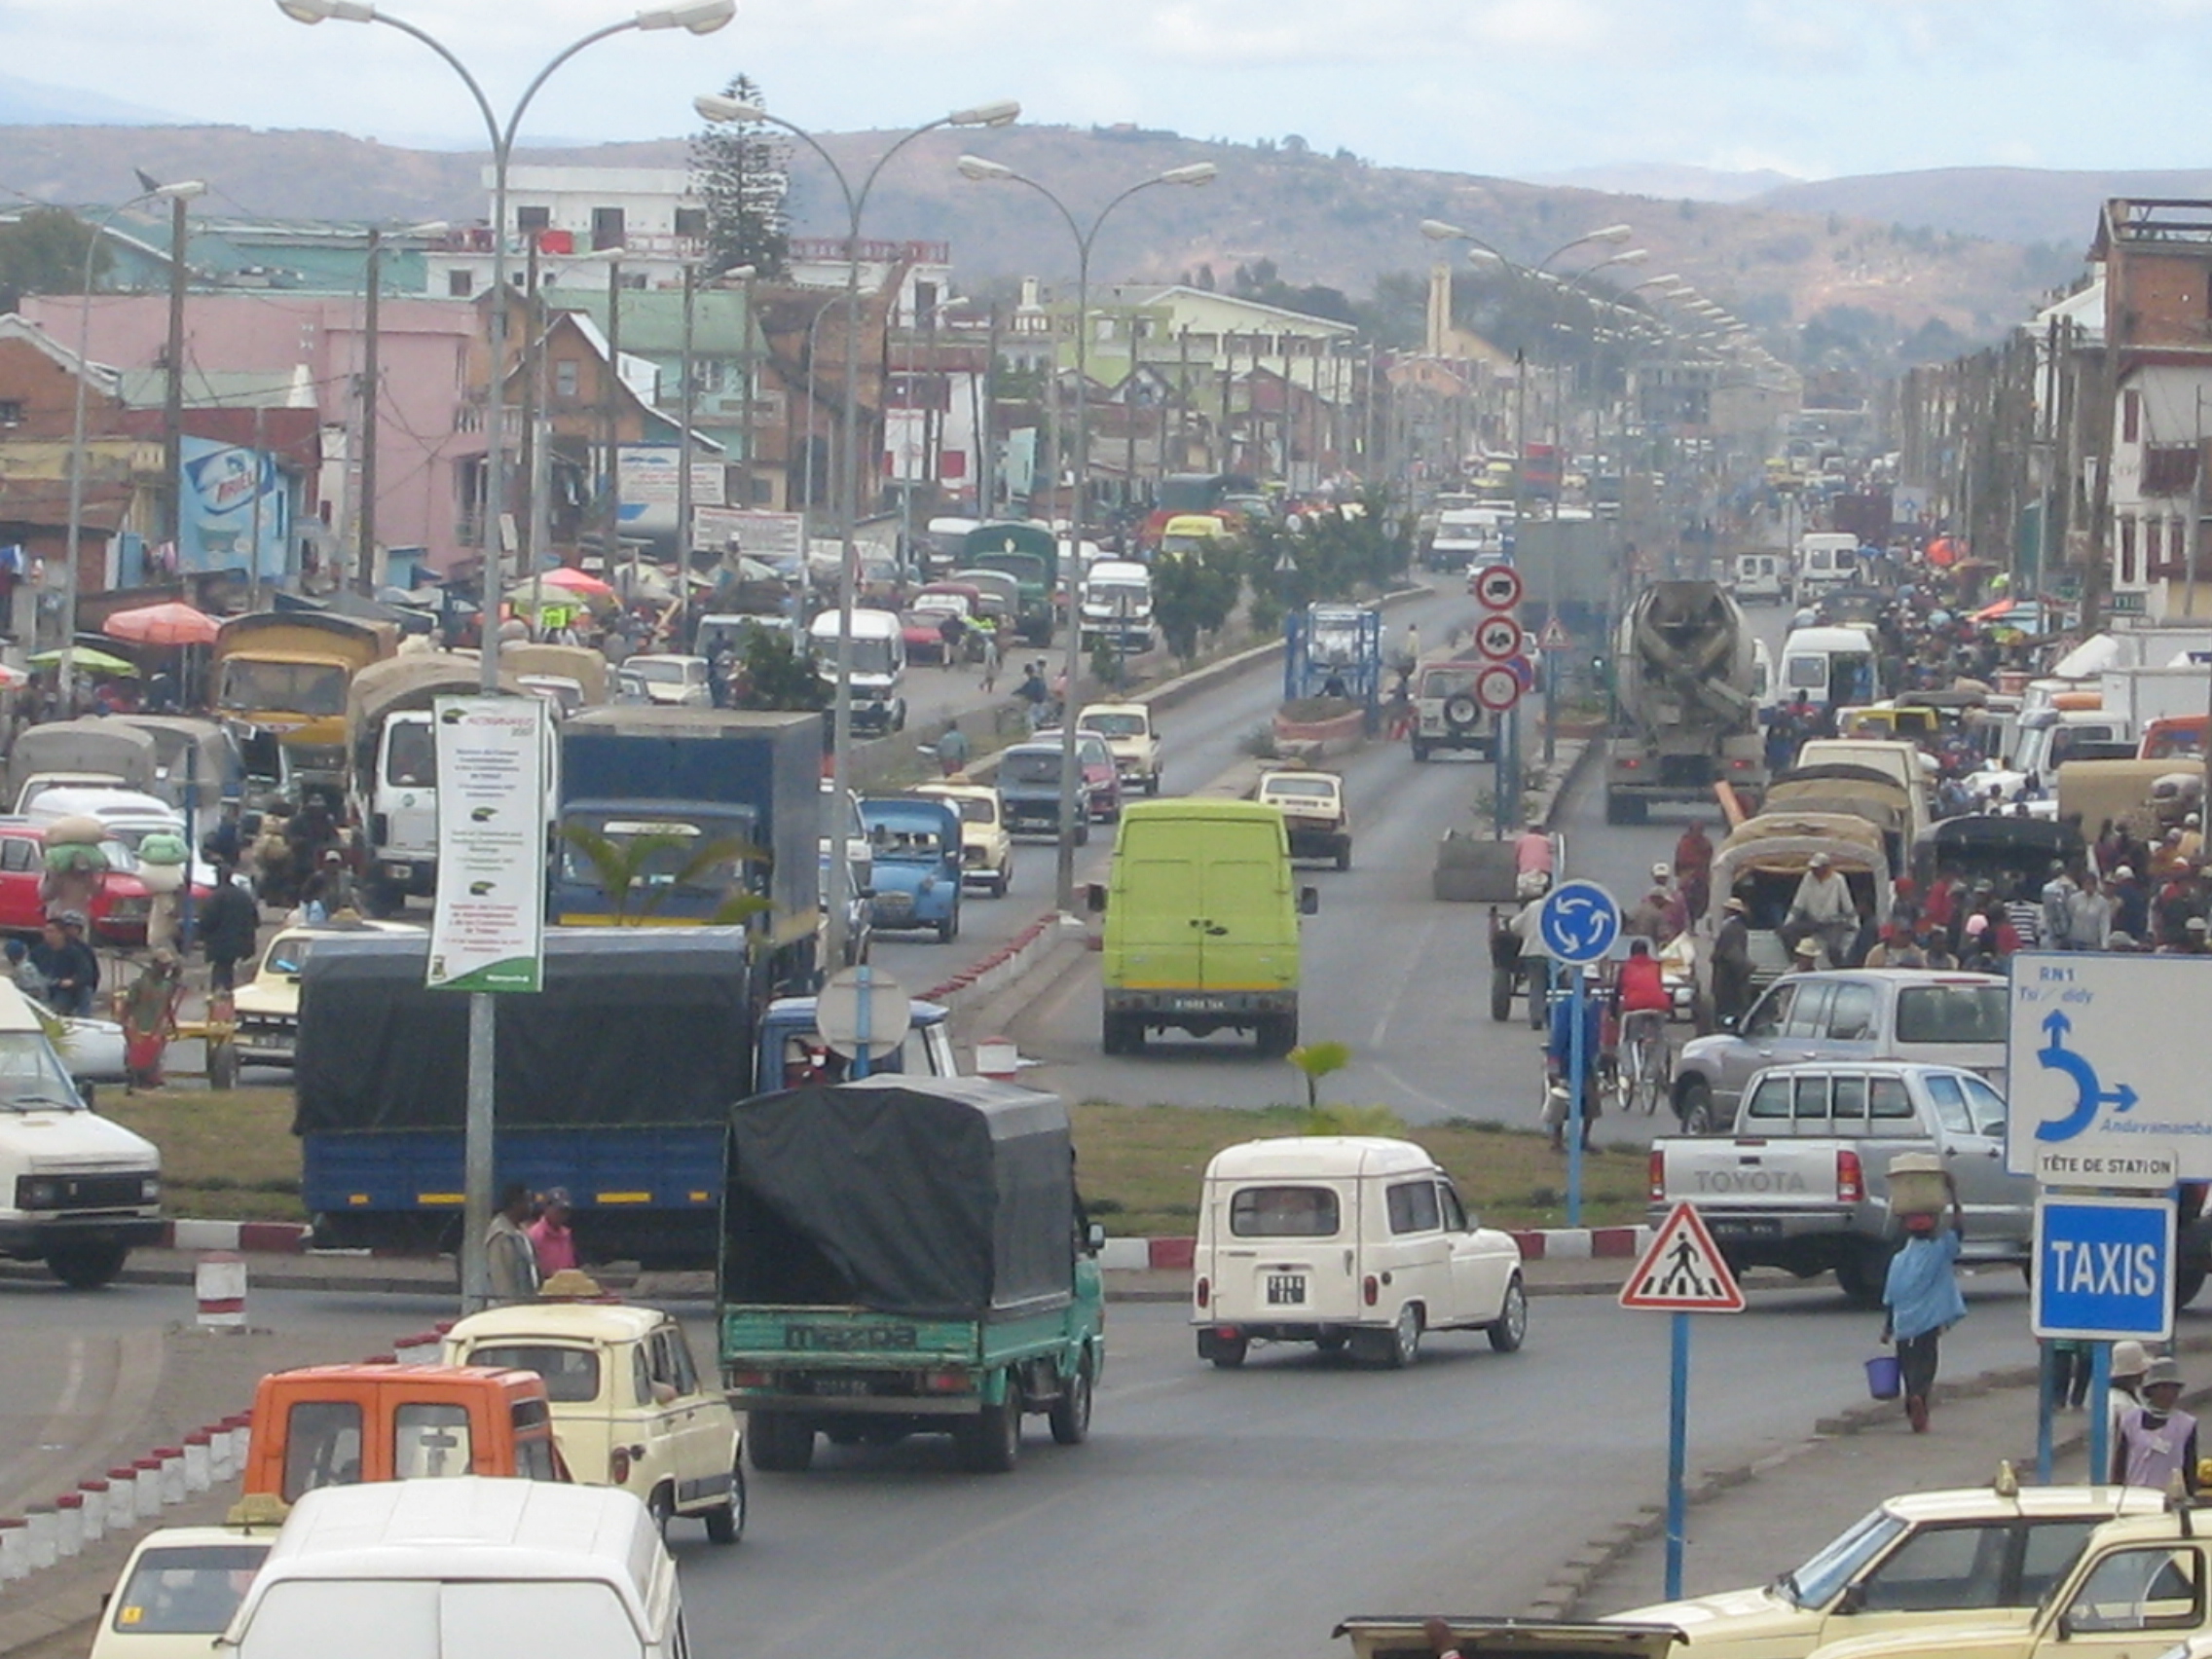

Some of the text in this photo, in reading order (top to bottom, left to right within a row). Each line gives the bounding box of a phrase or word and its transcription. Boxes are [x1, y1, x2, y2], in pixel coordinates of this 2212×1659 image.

[2043, 1153, 2171, 1174] TÊTE DE STATION
[1694, 1170, 1807, 1194] TOYOTA
[2050, 1240, 2157, 1297] TAXIS
